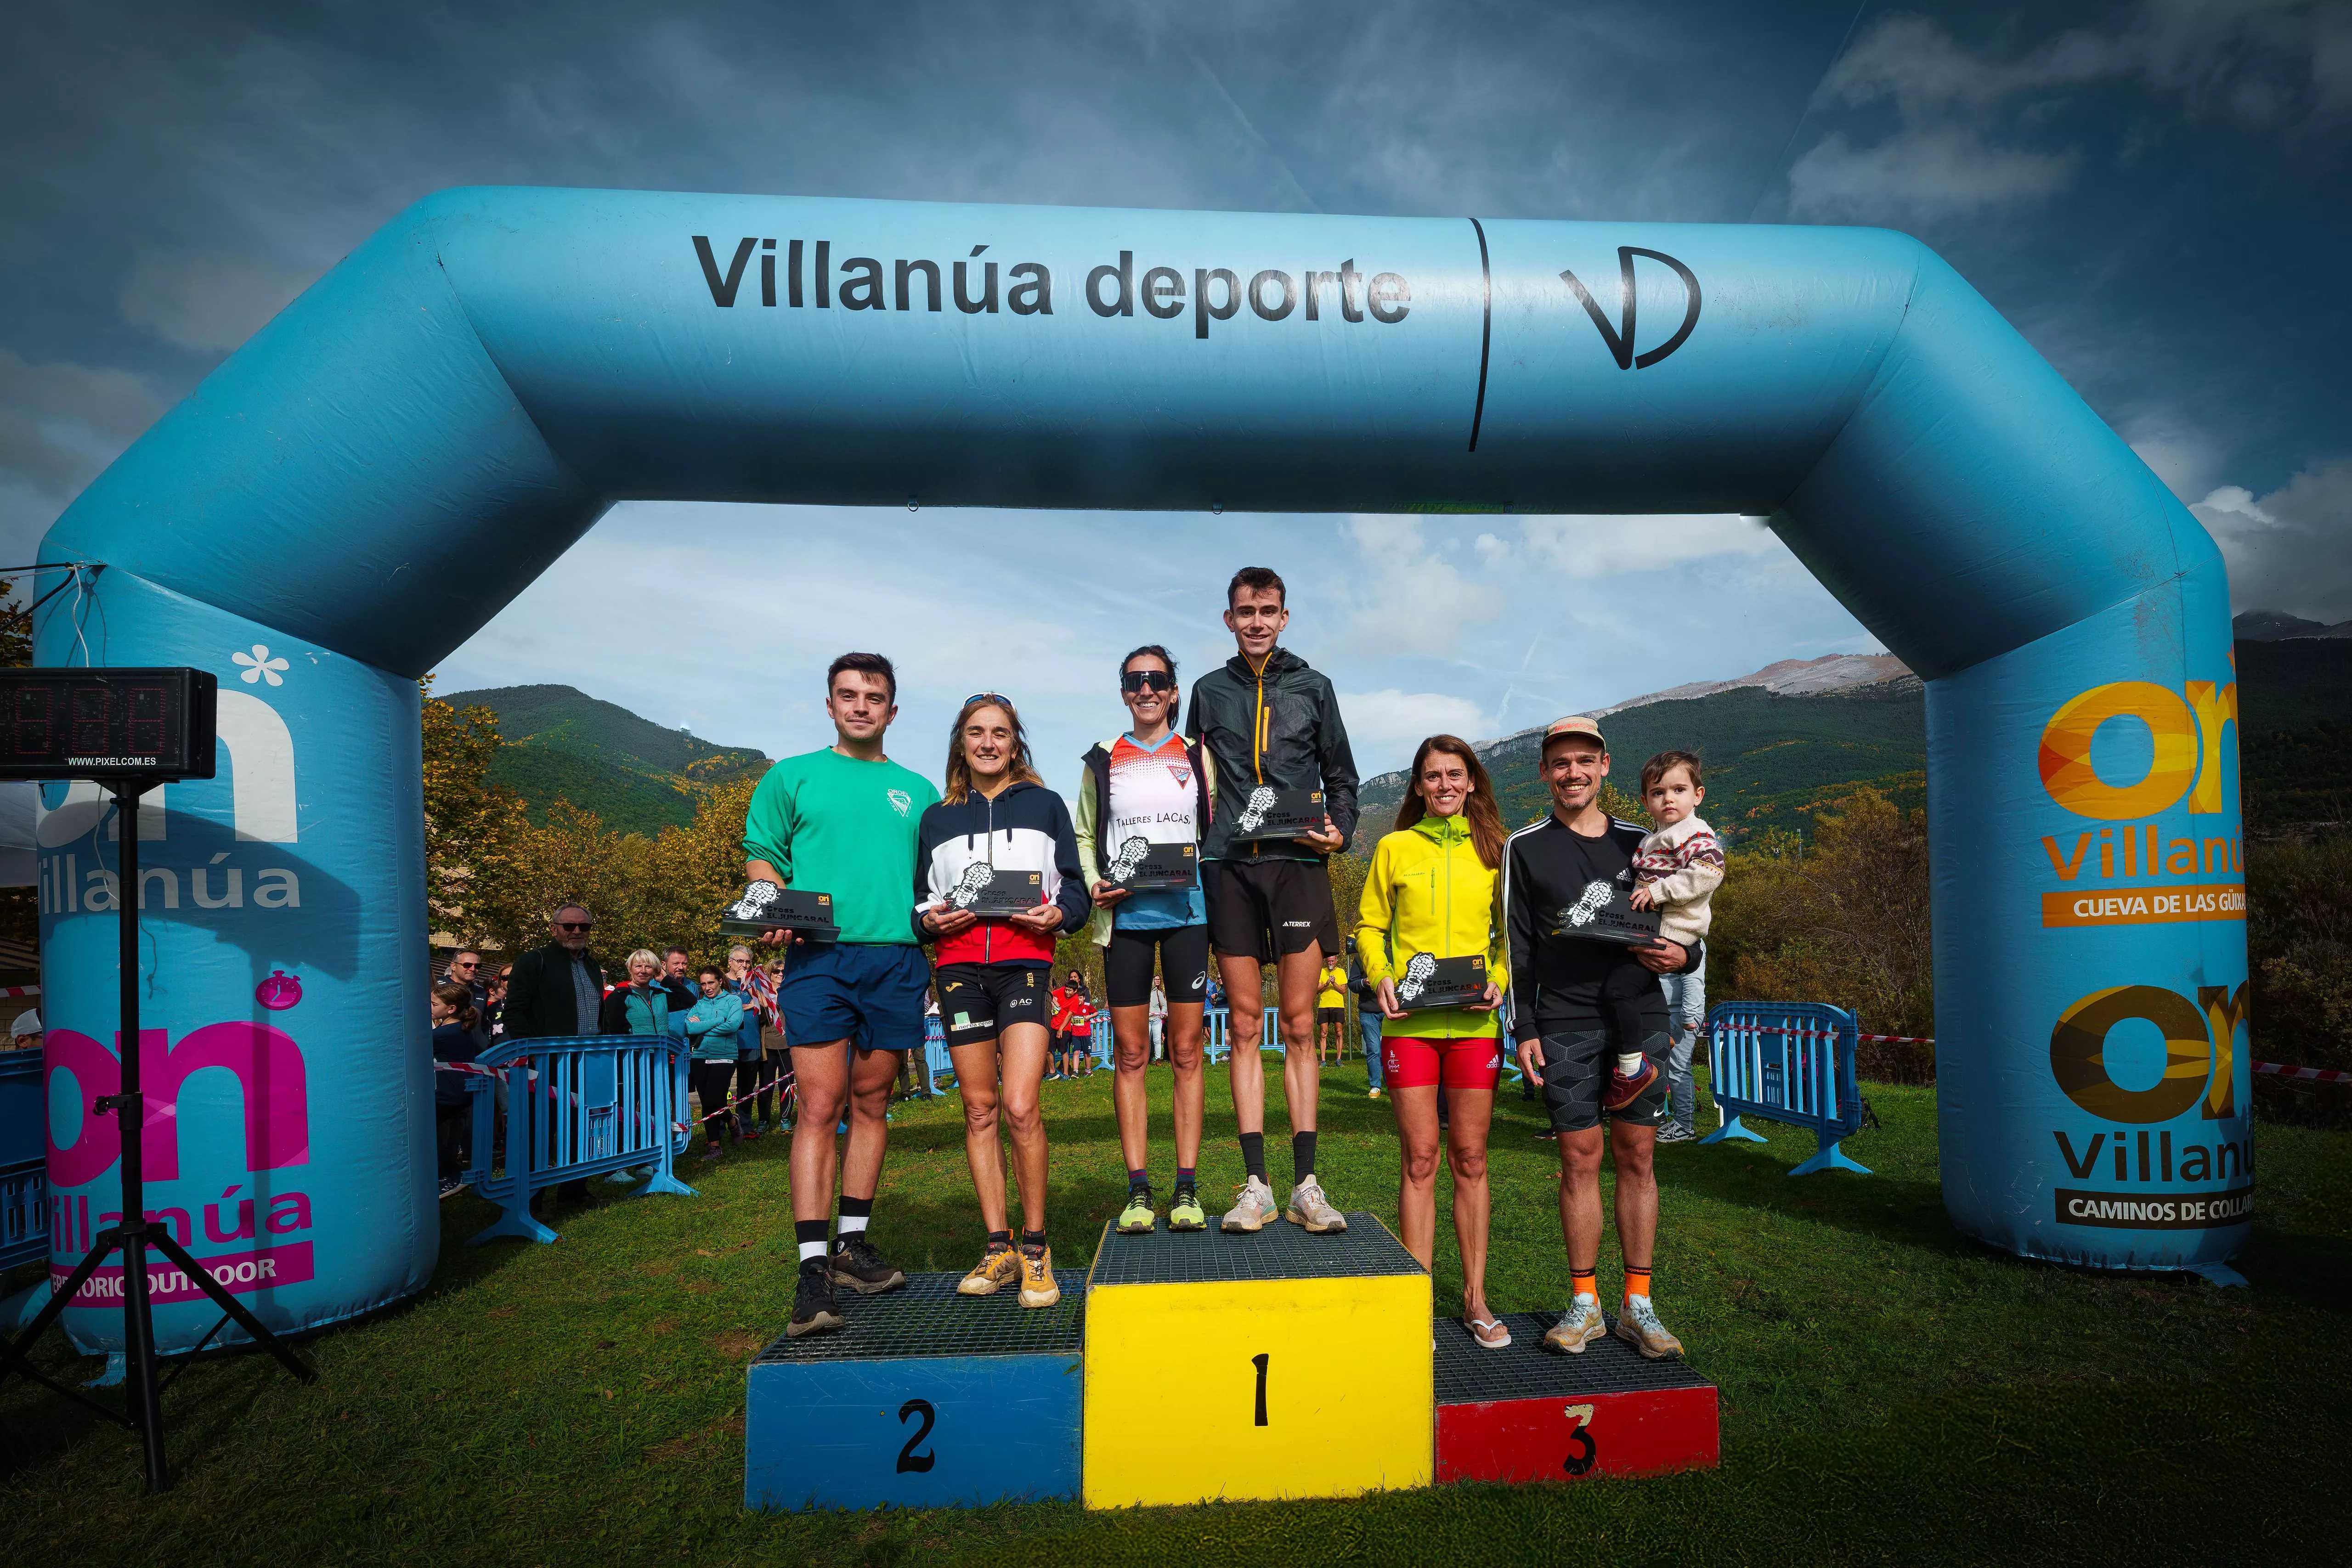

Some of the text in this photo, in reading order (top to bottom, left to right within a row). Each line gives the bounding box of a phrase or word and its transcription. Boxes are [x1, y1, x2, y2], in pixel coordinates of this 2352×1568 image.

[691, 235, 1411, 339] Villanúa deporte
[68, 757, 156, 766] WWW.PIXELCOM.ES
[888, 789, 910, 797] OROEL
[1116, 812, 1191, 828] TALLERES LACAS
[38, 852, 300, 914] illanúa
[766, 905, 794, 914] Cross
[1598, 910, 1625, 919] Cross
[2073, 888, 2246, 917] CUEVA DE LAS GÜIXA
[1608, 919, 1656, 932] JUNCARAL
[50, 1184, 313, 1254] illnúa
[2069, 1198, 2176, 1221] CAMINOS
[2182, 1201, 2205, 1220] DE
[1251, 1353, 1269, 1427] 1
[897, 1399, 935, 1474] 2
[1563, 1403, 1596, 1476] 3
